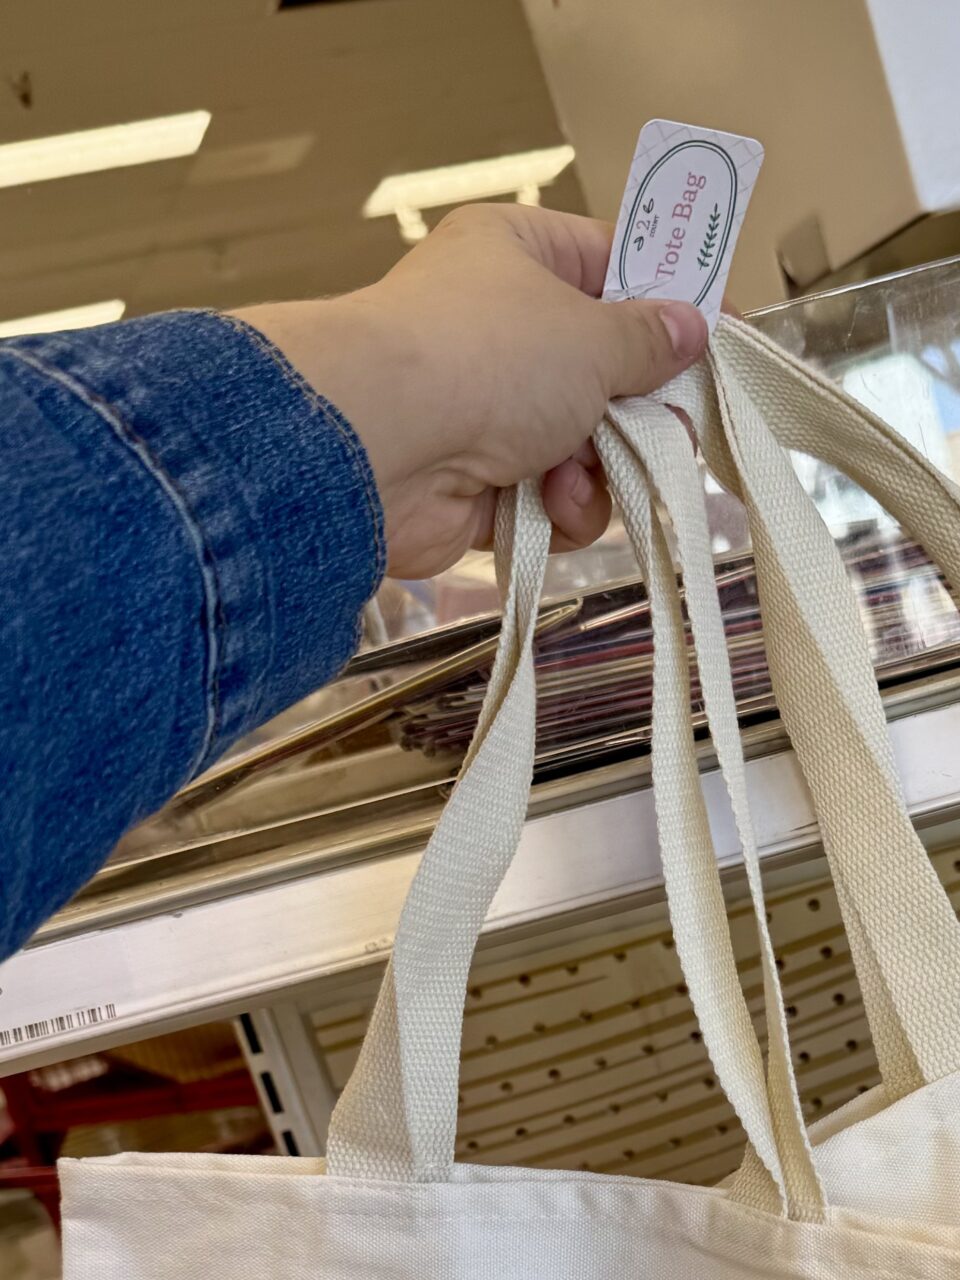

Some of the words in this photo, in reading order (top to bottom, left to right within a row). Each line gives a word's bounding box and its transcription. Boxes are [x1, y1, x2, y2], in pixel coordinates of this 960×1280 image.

[636, 220, 651, 231] 2
[649, 214, 661, 238] COUNT
[655, 227, 686, 280] Tote
[672, 172, 707, 222] Bag
